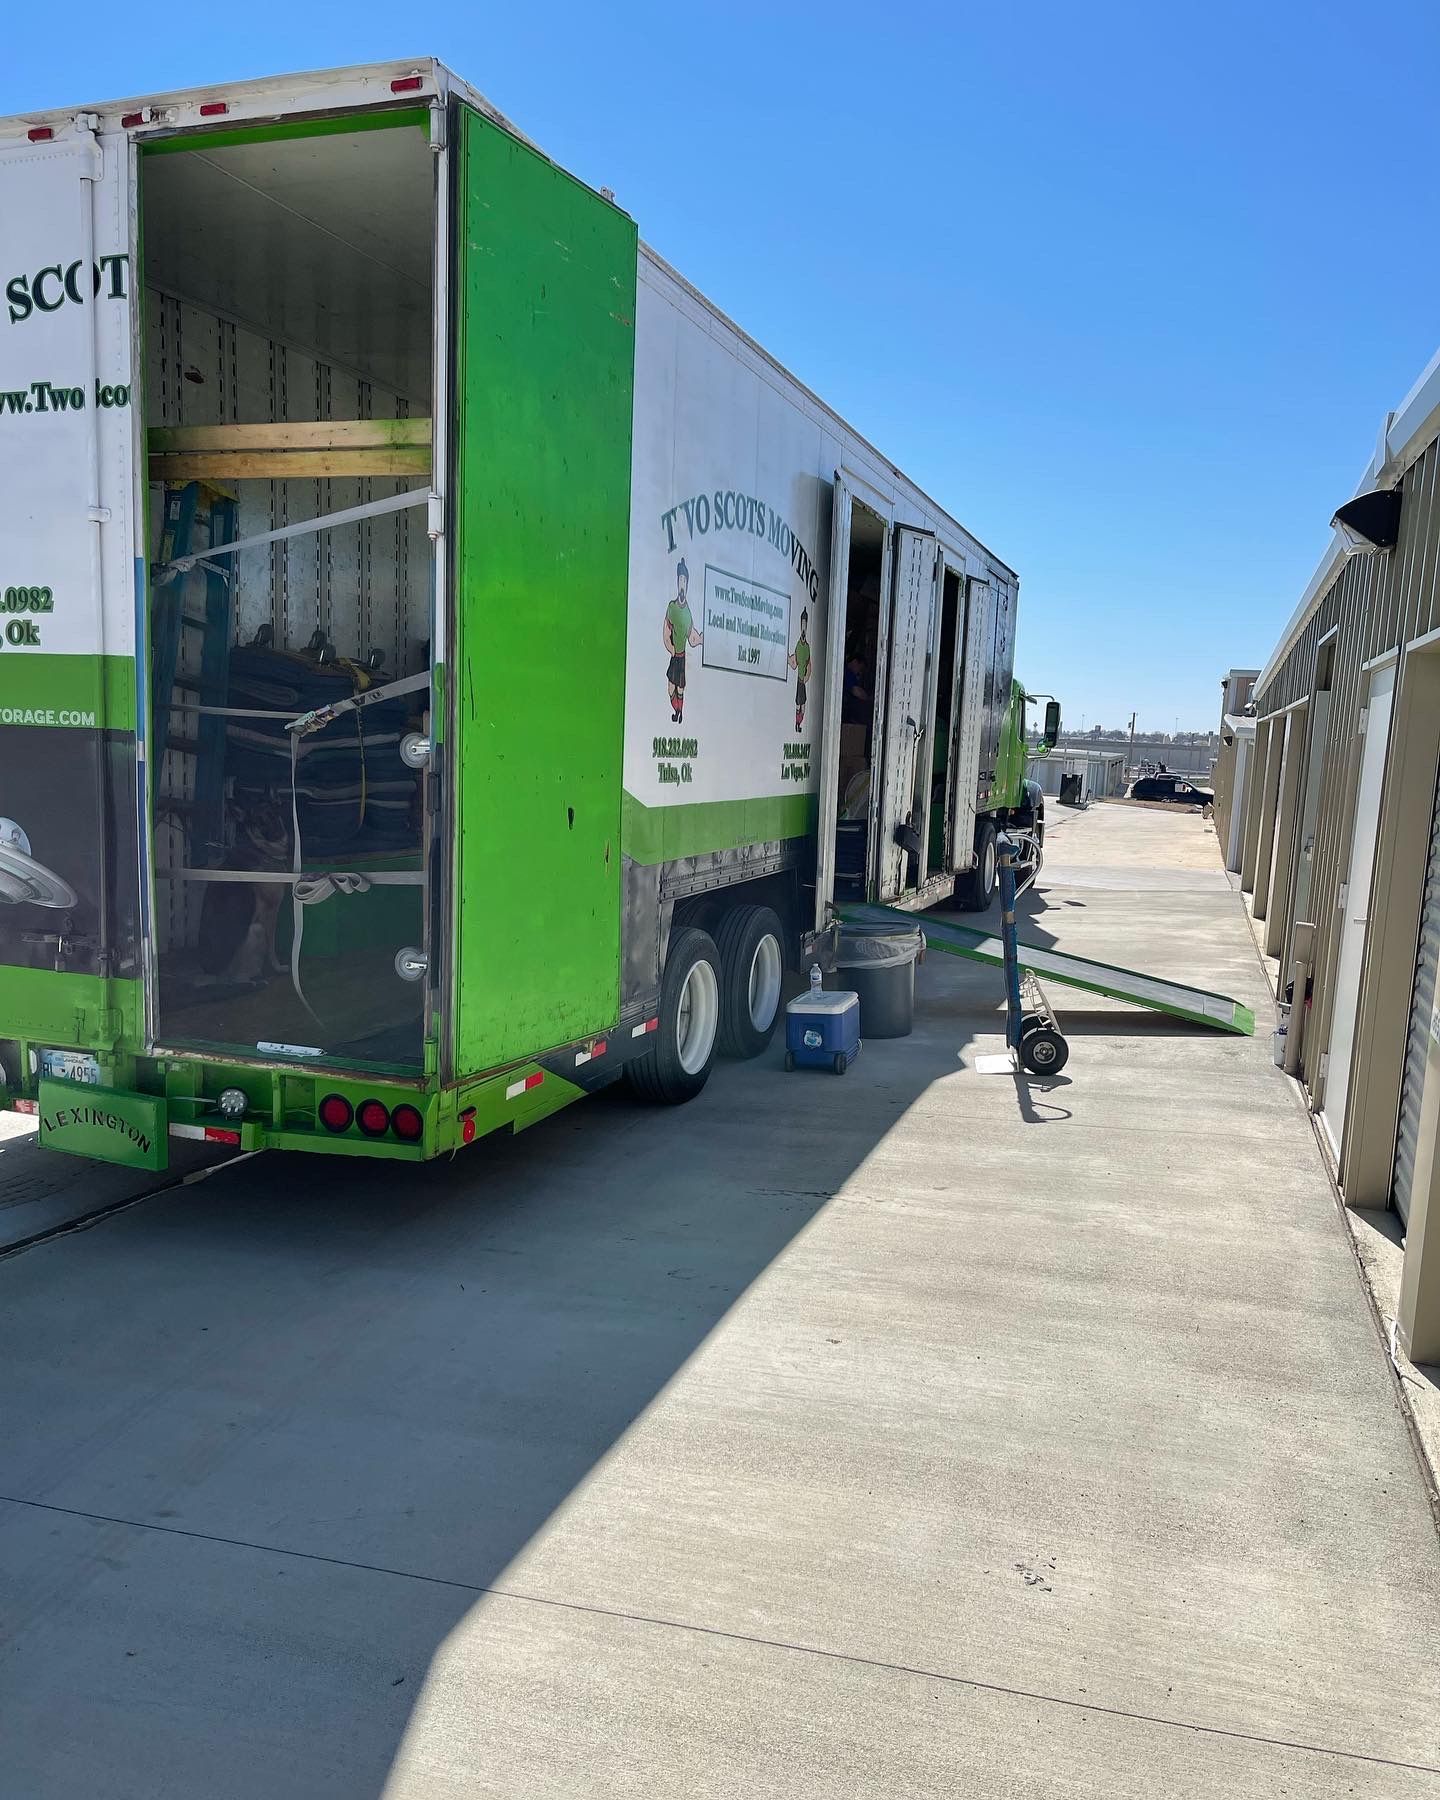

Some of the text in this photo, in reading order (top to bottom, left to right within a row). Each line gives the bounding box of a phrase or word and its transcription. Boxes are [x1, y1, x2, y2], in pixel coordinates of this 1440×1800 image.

[714, 490, 766, 538] SCOTS
[768, 507, 819, 603] MOVING
[6, 619, 41, 646] Ok
[708, 609, 725, 630] Local
[725, 616, 737, 633] and
[737, 617, 760, 639] National
[747, 647, 761, 665] 1997
[43, 1107, 151, 1154] LEXINGTON
